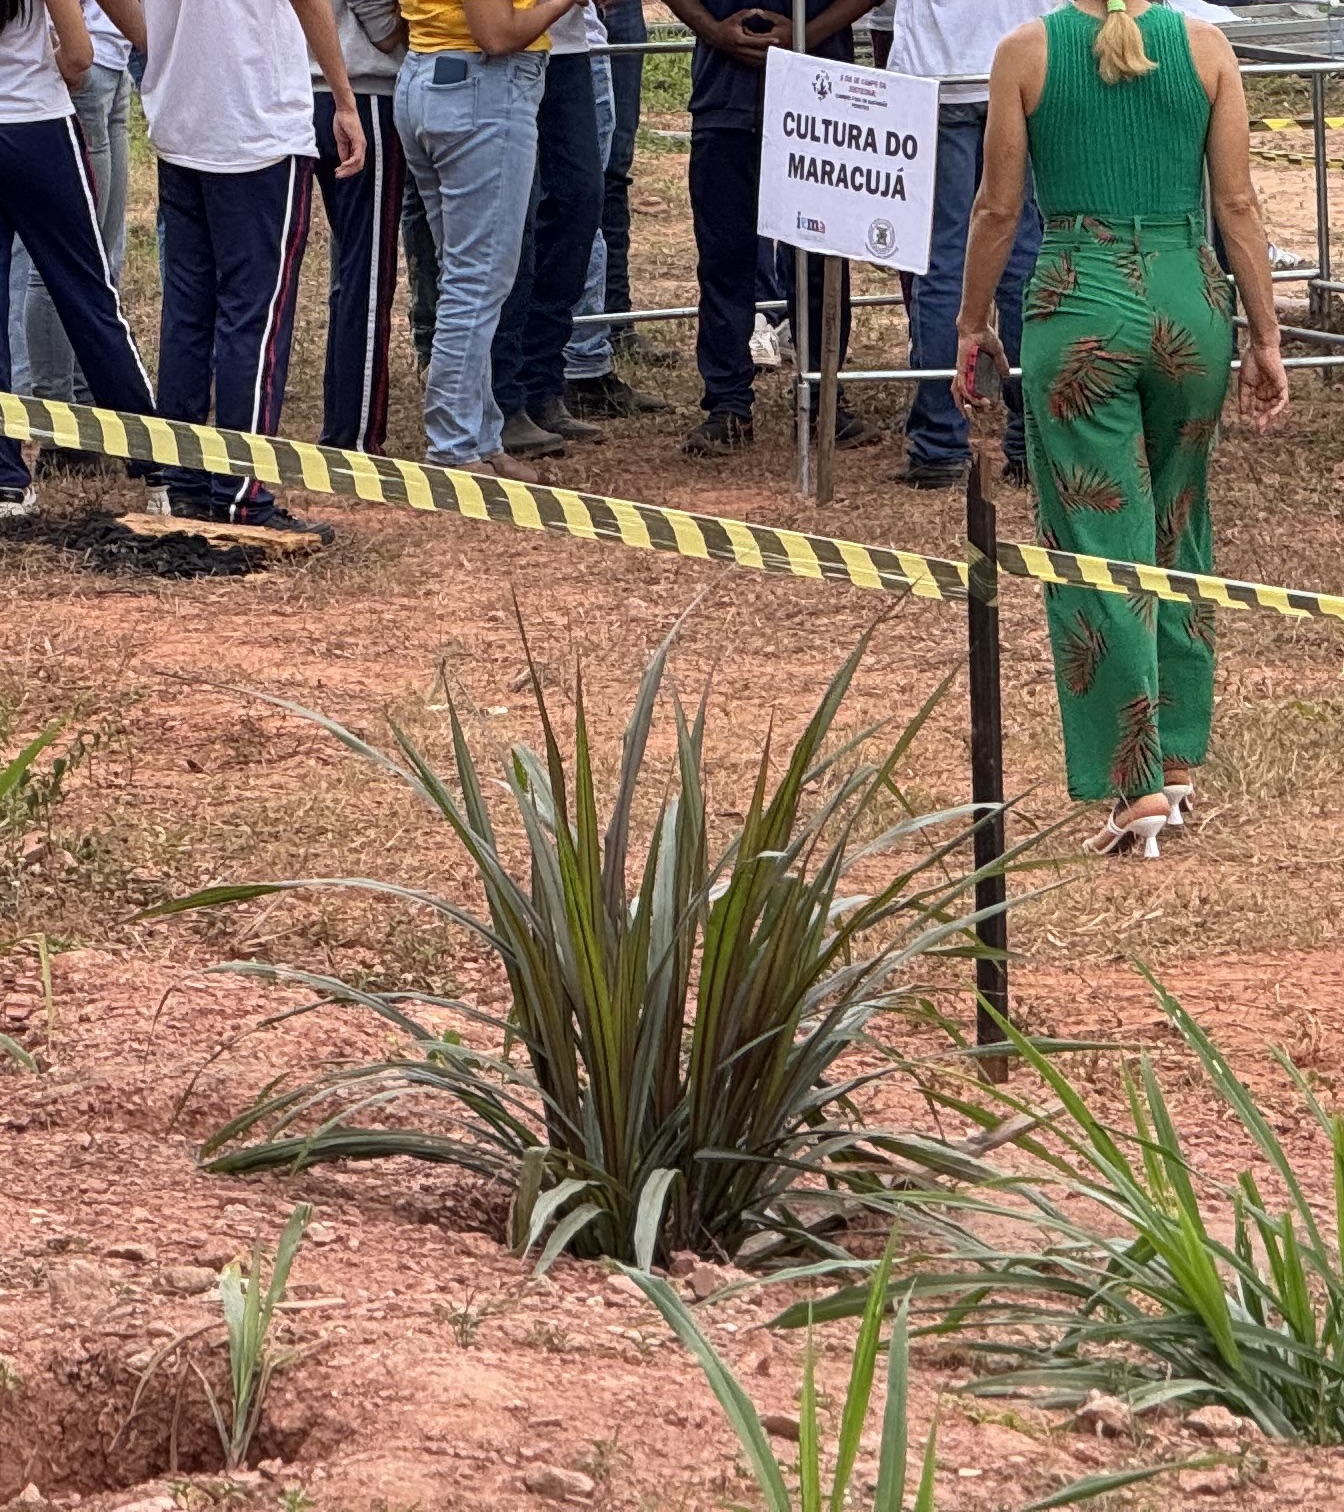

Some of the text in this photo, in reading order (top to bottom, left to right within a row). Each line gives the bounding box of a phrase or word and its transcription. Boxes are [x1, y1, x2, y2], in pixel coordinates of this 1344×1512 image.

[783, 111, 918, 161] CULTURA DO
[787, 152, 907, 202] MARACUJÁ
